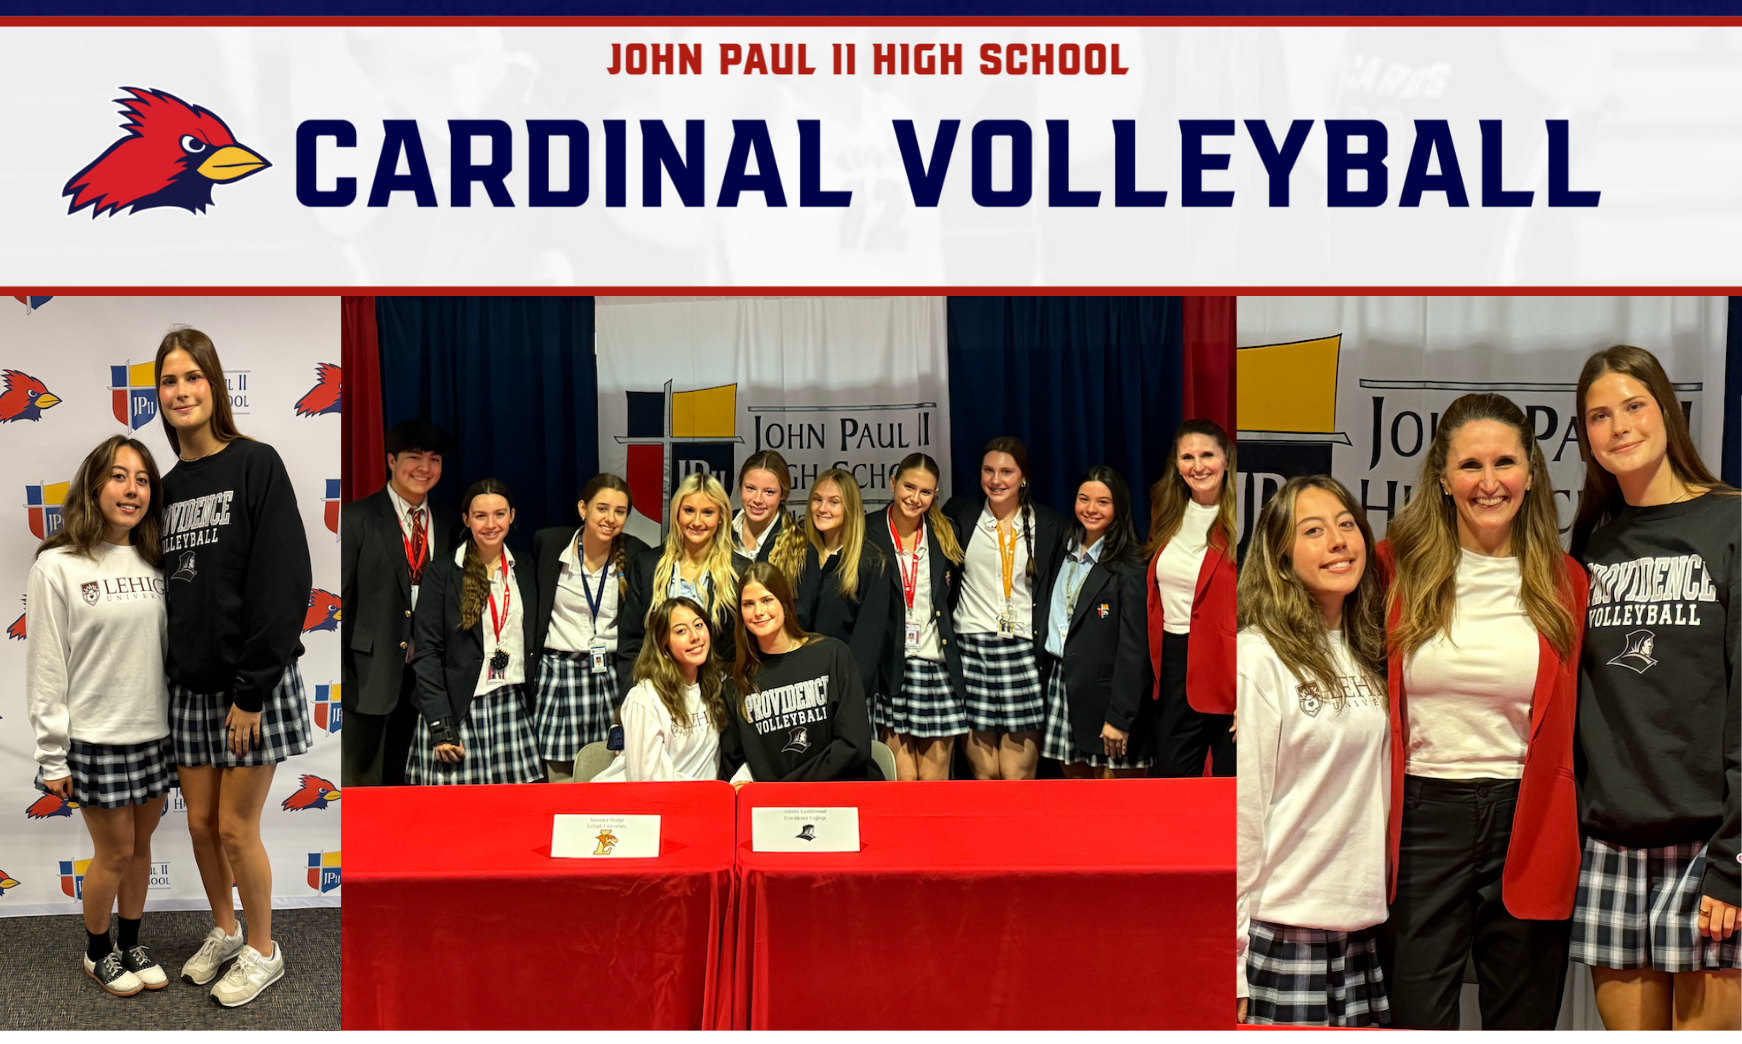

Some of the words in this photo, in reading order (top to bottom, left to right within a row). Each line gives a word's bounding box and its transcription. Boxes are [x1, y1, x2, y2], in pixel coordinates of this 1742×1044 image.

[840, 418, 910, 451] PAUL
[161, 527, 219, 555] OLLEYBALL
[102, 576, 165, 596] LEHIG
[1588, 603, 1701, 629] VOLLEYBALL
